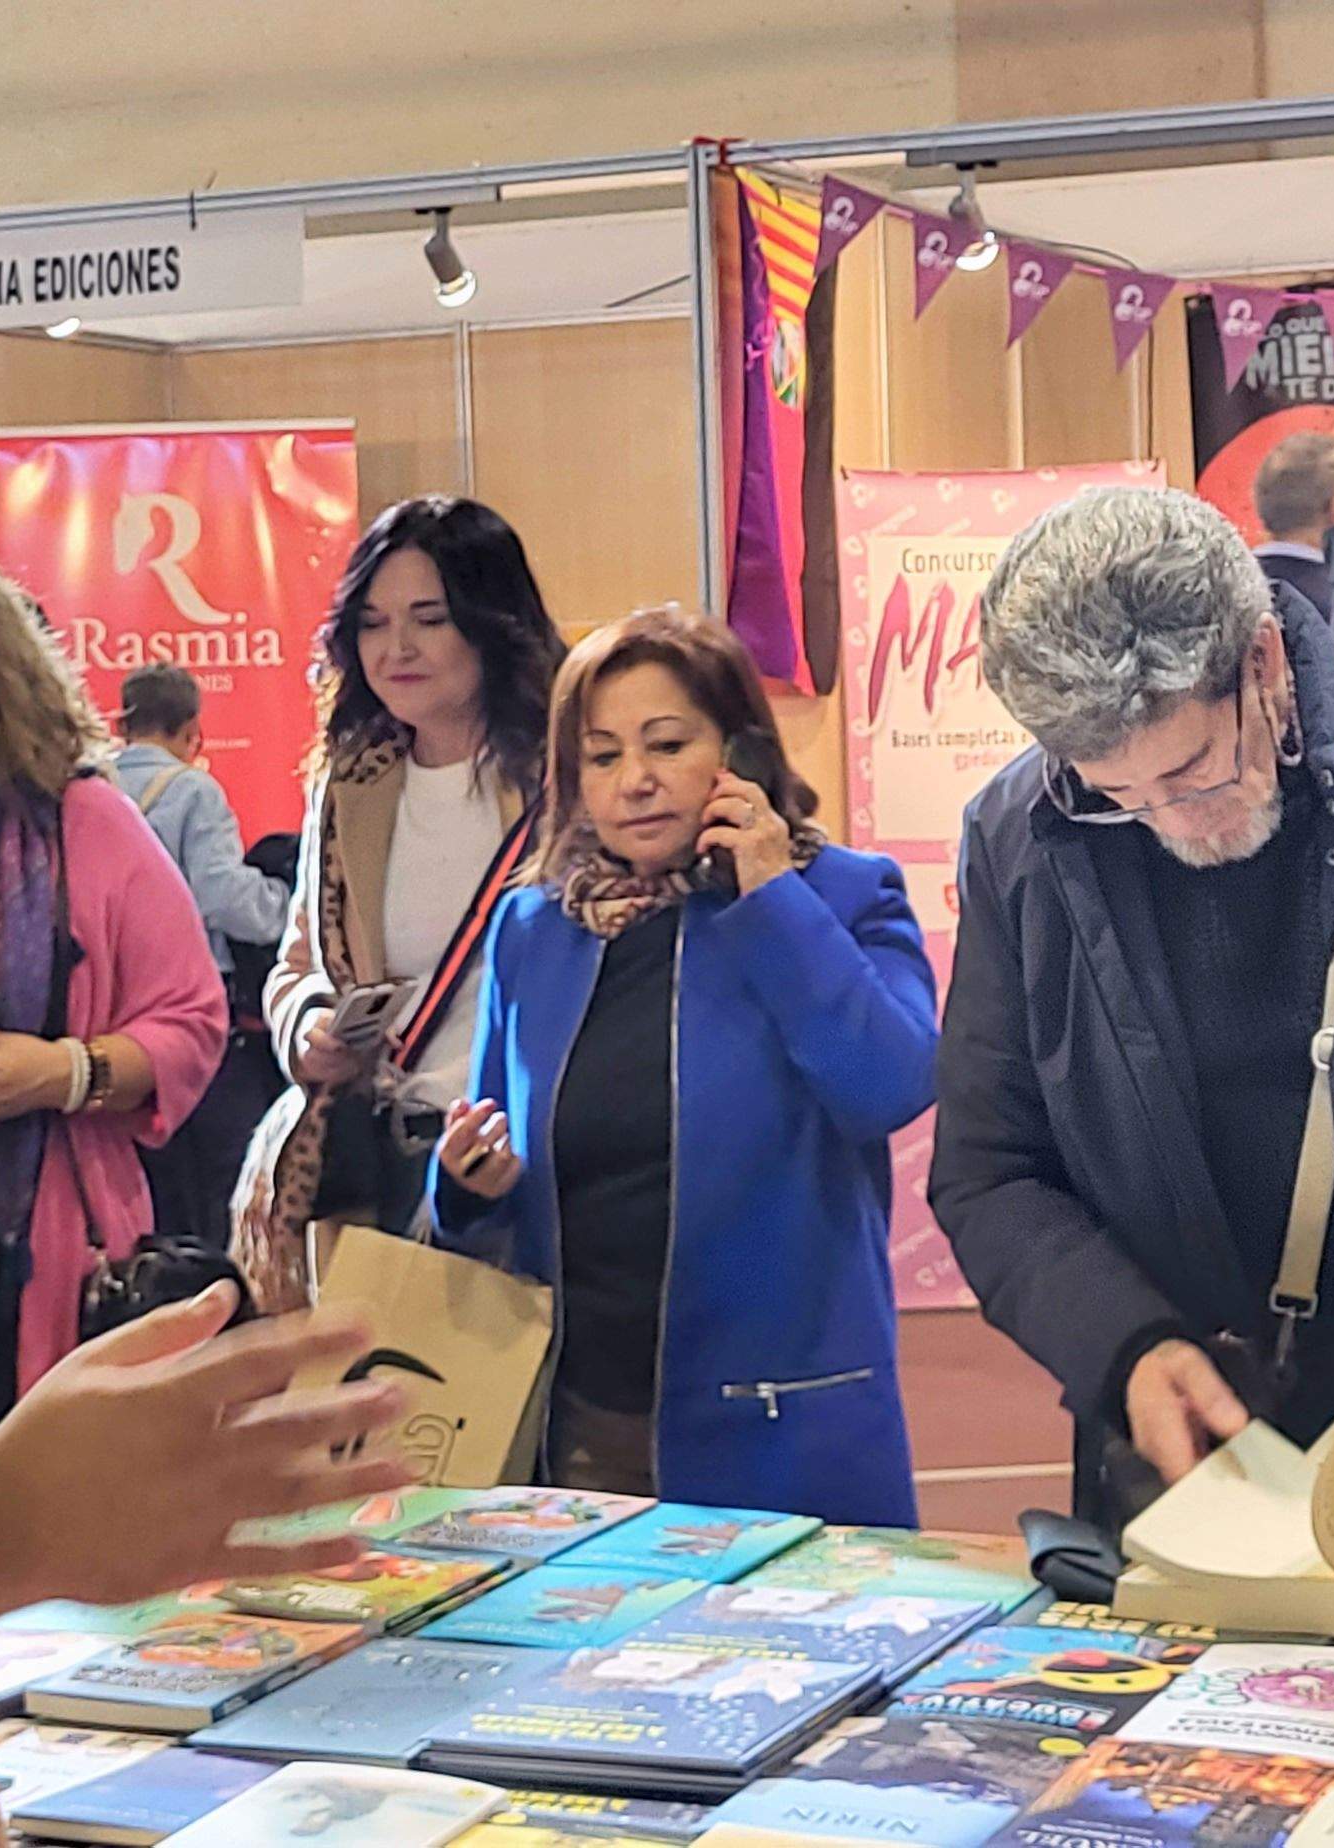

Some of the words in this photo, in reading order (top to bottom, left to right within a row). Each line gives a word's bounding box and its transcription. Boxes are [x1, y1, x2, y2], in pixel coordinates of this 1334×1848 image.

[33, 246, 181, 302] EDICIONES
[1282, 377, 1317, 400] TE
[901, 548, 997, 574] Concurso
[69, 612, 285, 670] Rasmia
[892, 729, 932, 748] Bases
[937, 727, 1015, 749] completas
